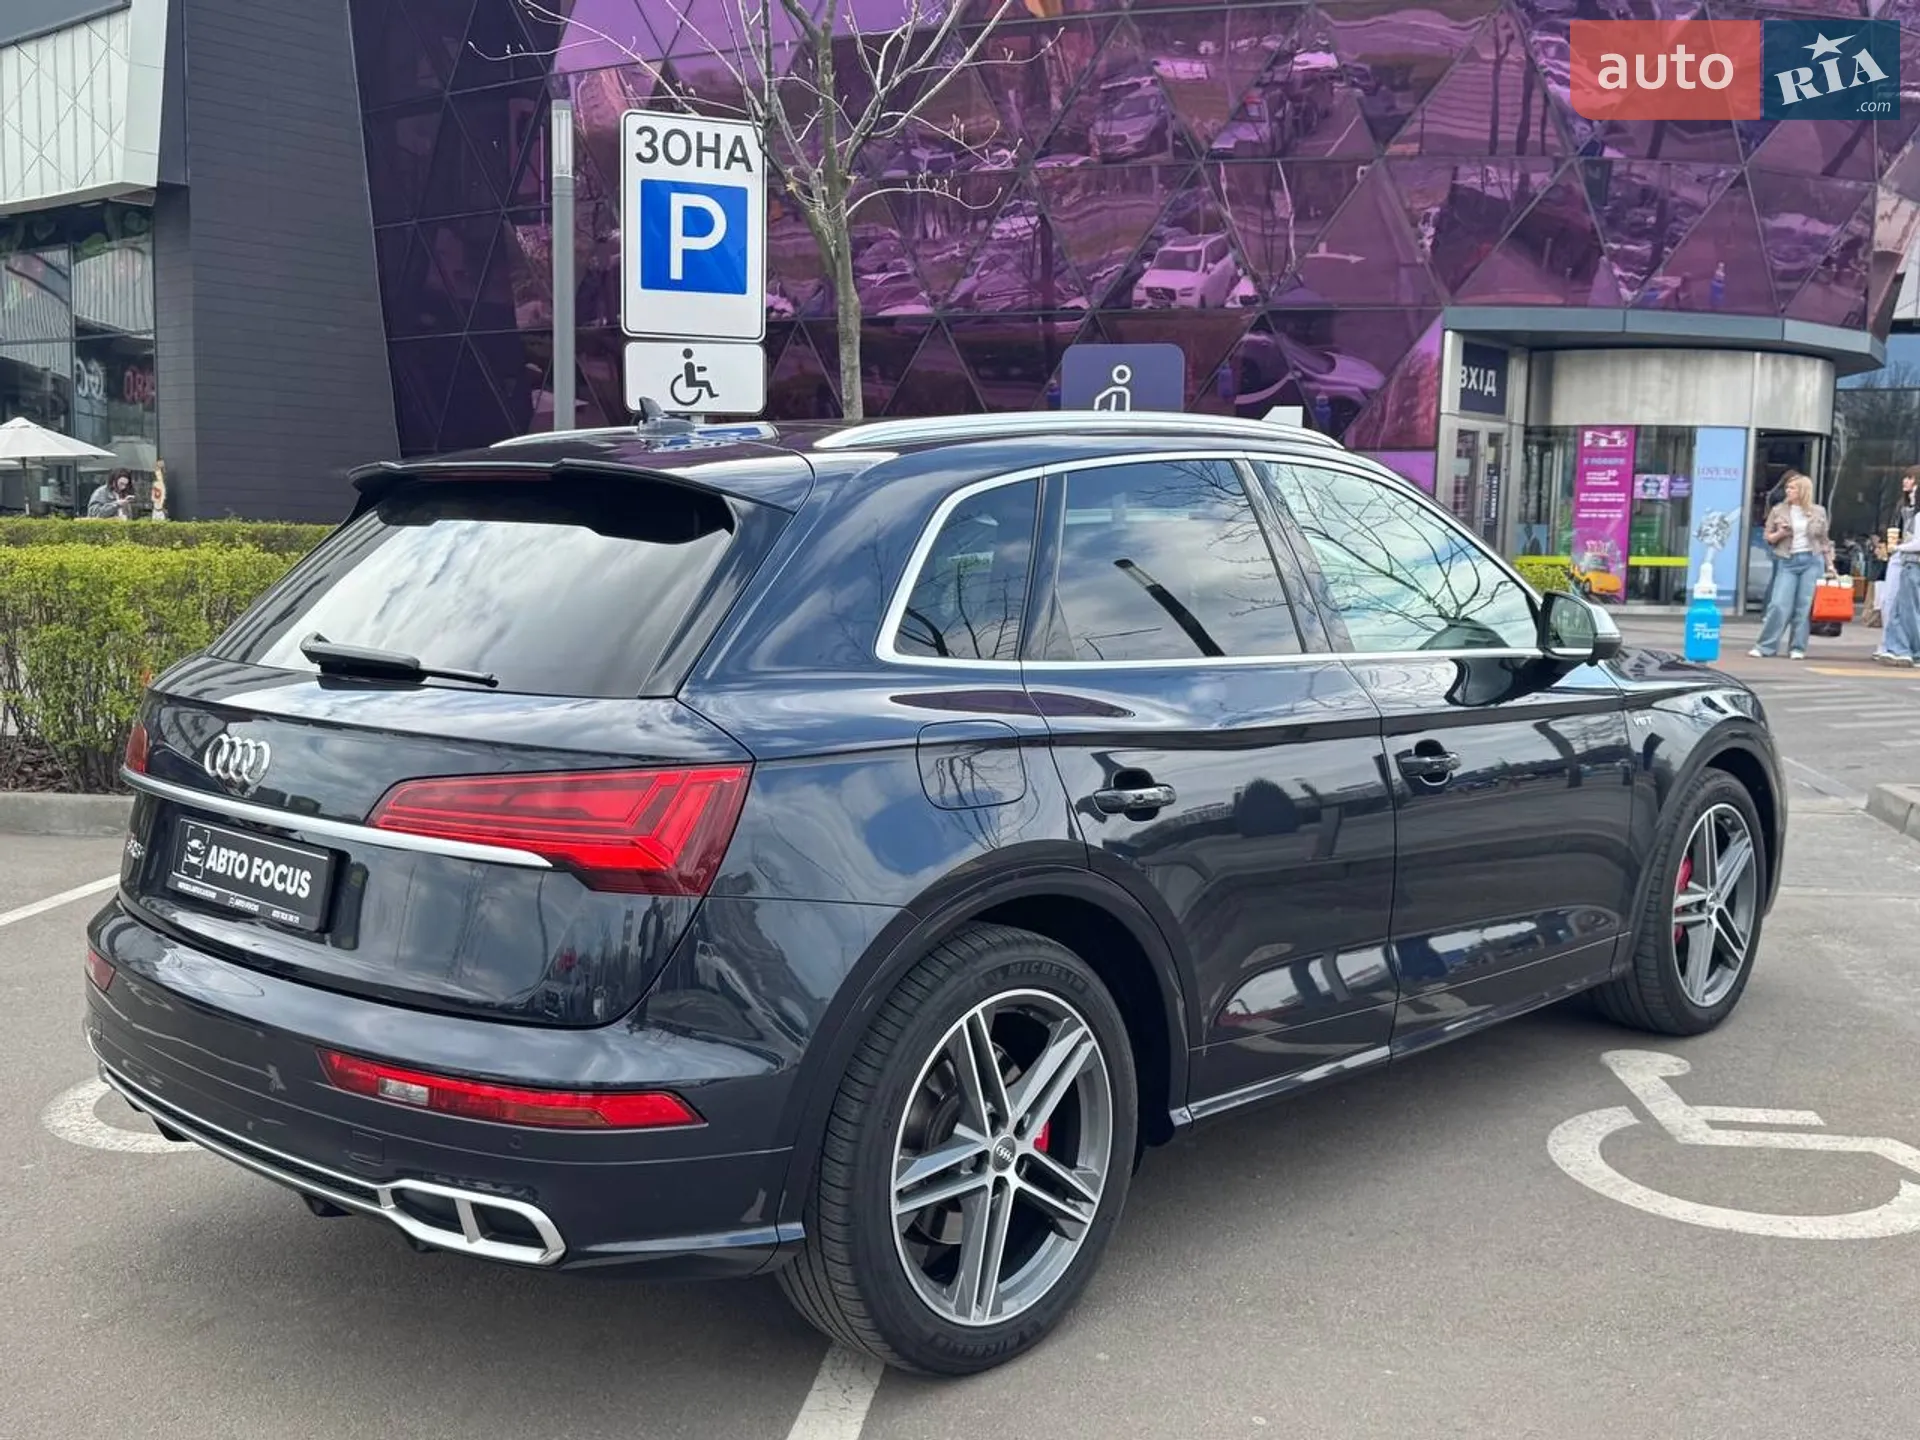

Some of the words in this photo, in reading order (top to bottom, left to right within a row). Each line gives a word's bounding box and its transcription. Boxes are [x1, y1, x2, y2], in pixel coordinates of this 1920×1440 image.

[635, 125, 753, 172] ЗОНА
[670, 192, 727, 280] P
[250, 857, 312, 898] FOCUS
